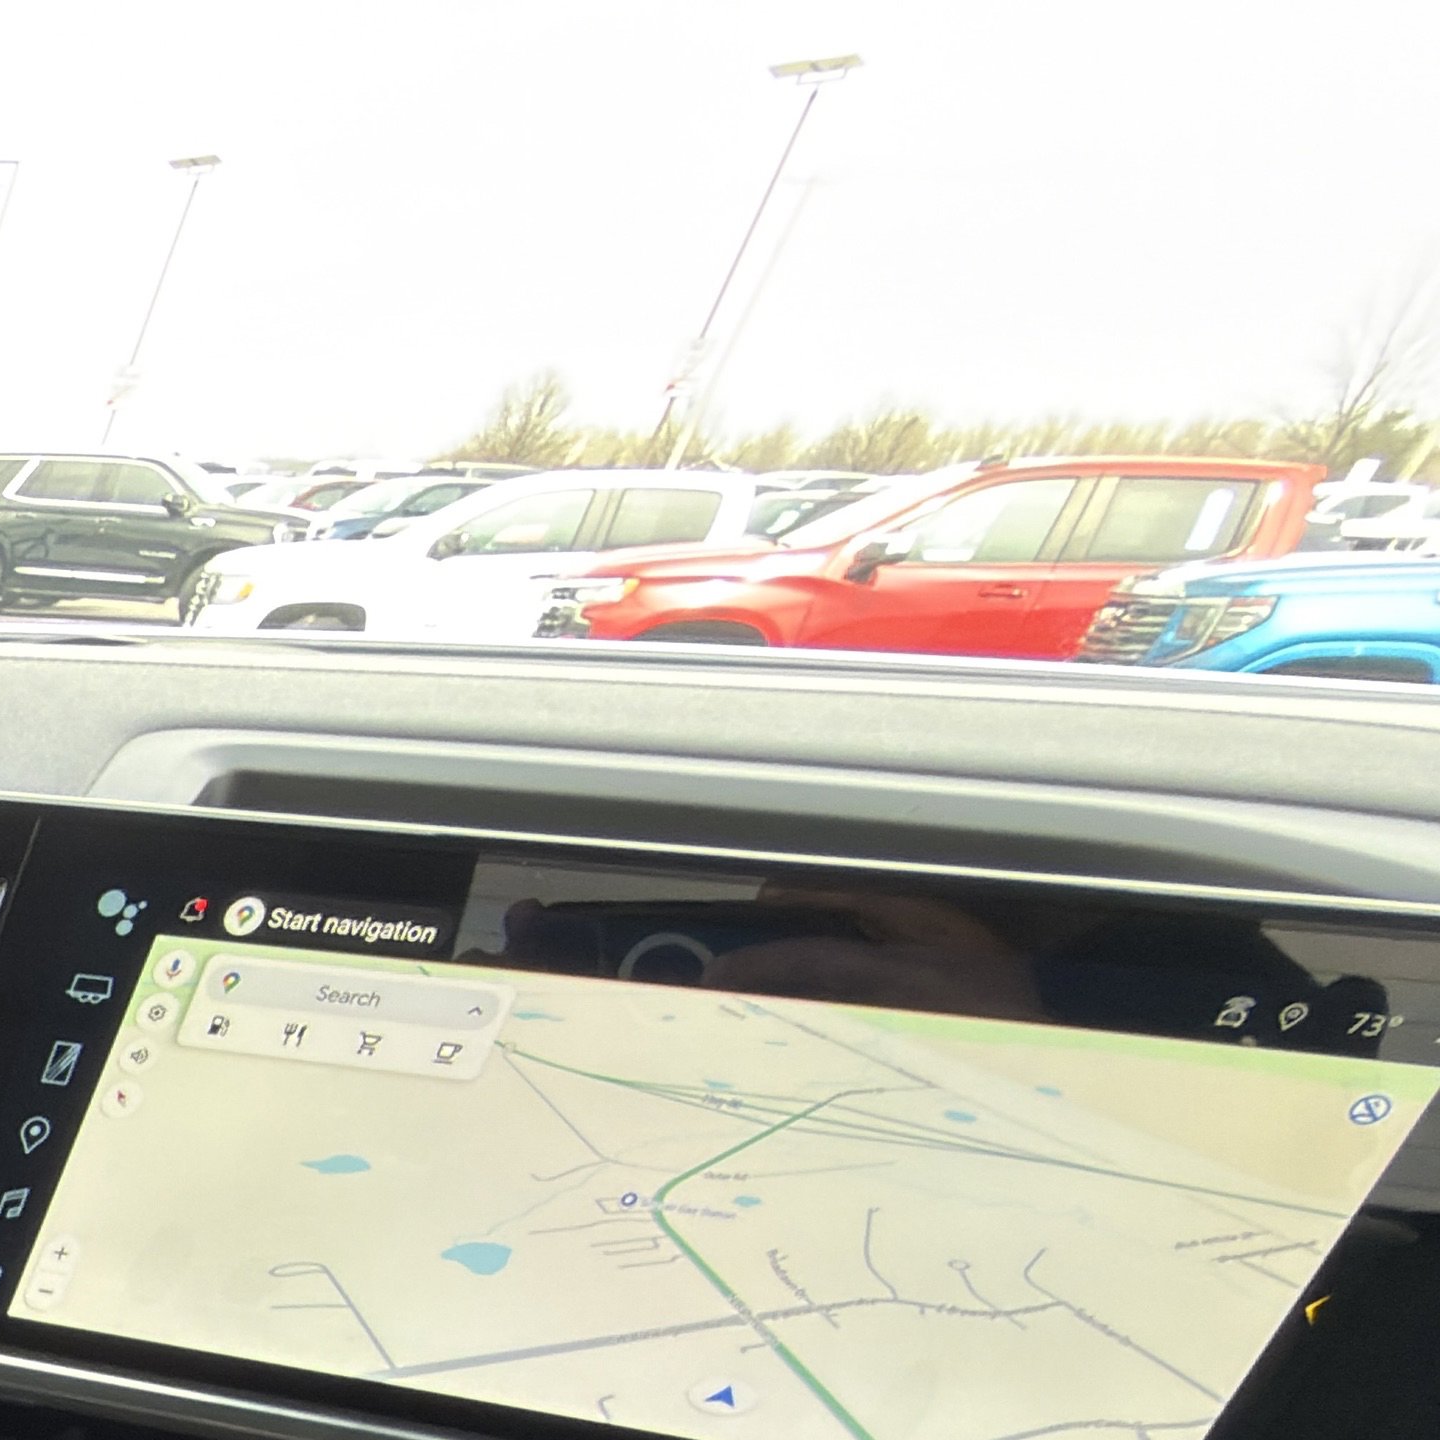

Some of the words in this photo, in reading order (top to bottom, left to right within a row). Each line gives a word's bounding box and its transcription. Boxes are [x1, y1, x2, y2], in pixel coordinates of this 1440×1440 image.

[268, 907, 322, 932] Start
[323, 916, 438, 944] navigation
[315, 984, 381, 1008] Search
